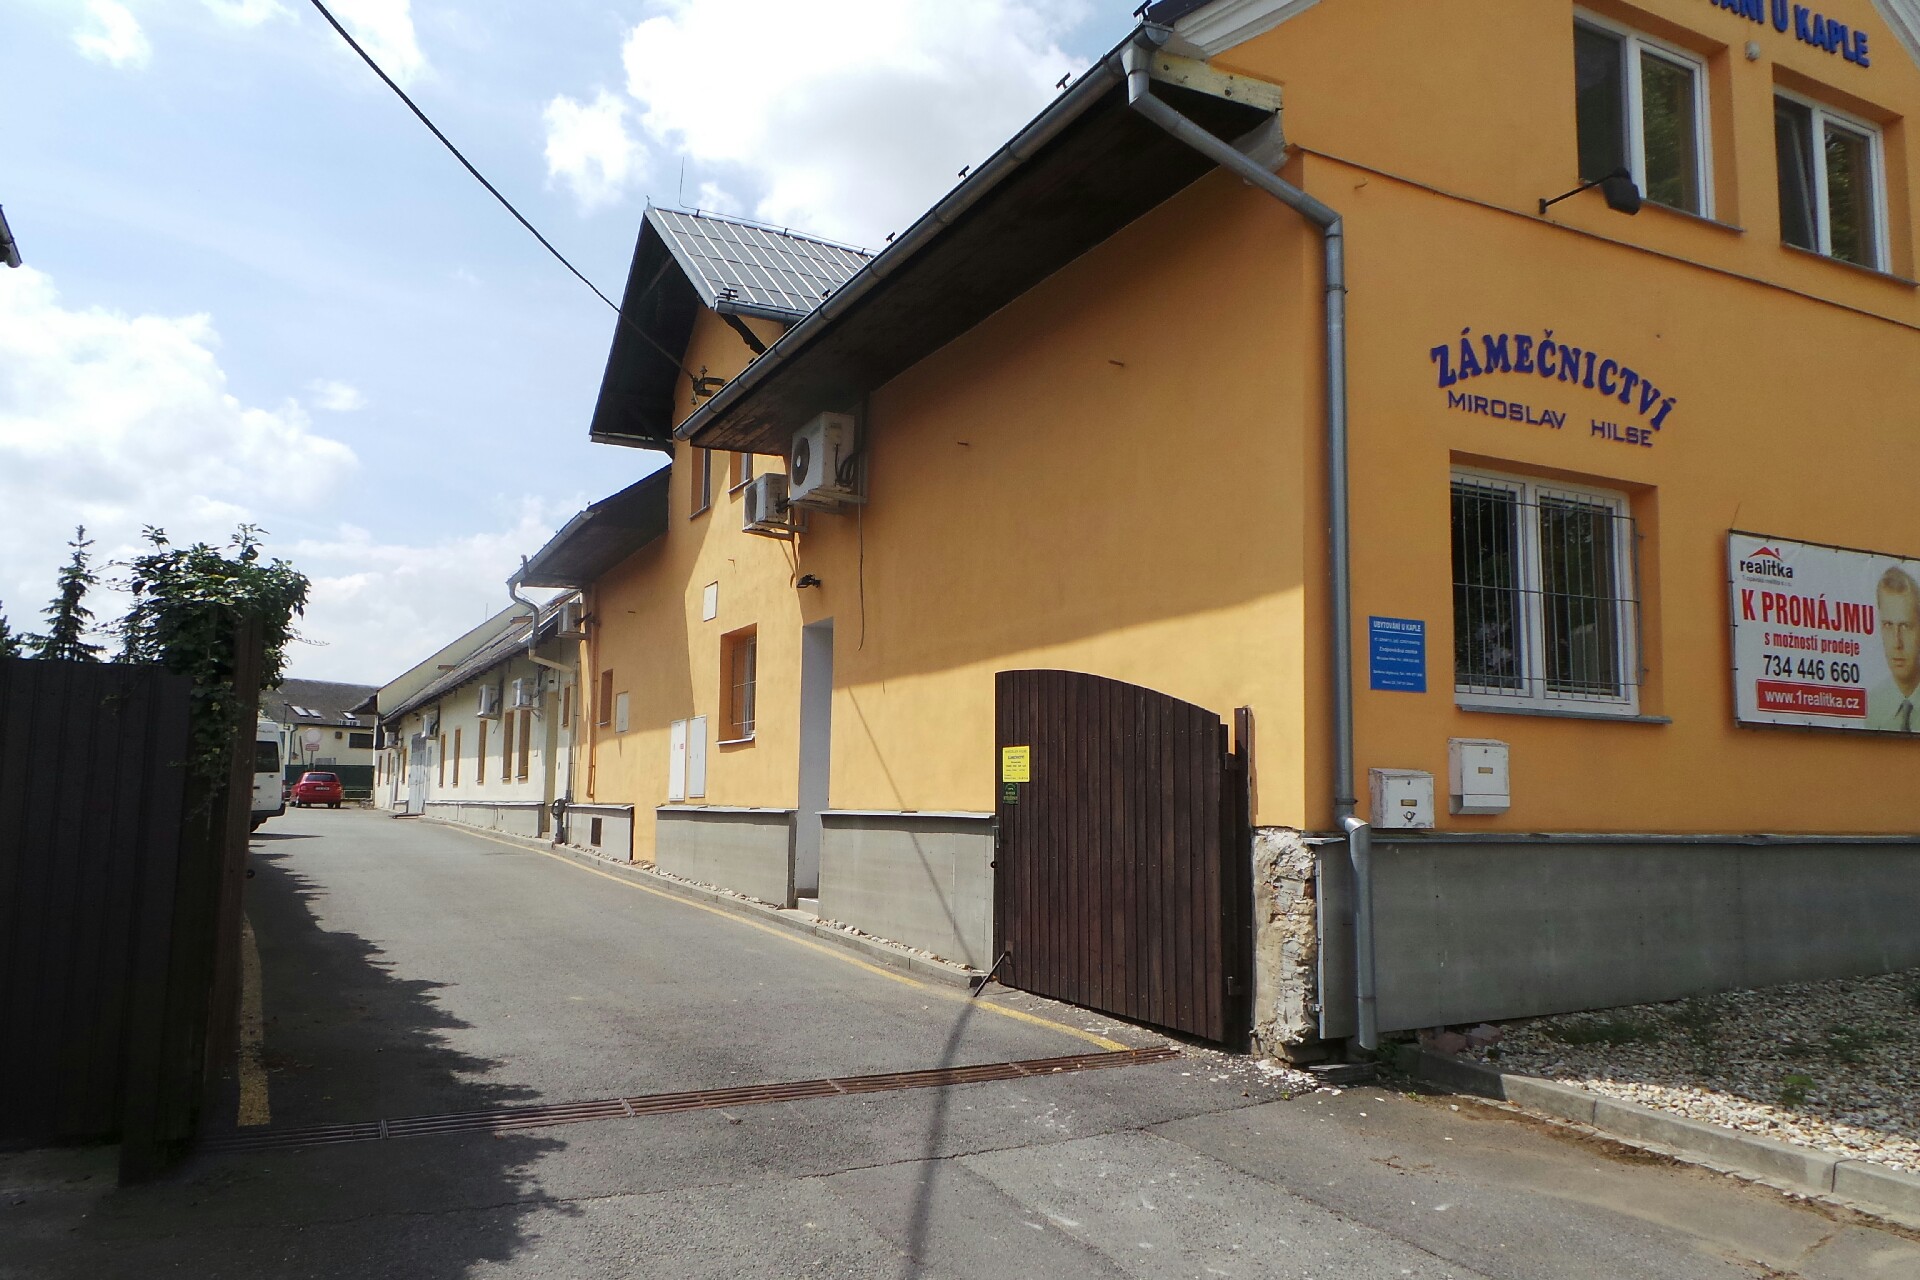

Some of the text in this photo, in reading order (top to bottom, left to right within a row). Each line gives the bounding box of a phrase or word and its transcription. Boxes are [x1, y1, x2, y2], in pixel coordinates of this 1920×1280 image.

[1771, 0, 1789, 33] U
[1794, 4, 1870, 68] KAPLE
[1430, 327, 1677, 431] ZÁMEČNICTVÍ
[1447, 389, 1653, 448] MIROSLAV HILSE
[1739, 559, 1793, 579] realitka
[1741, 588, 1874, 636] K PRONÁJMU
[1764, 632, 1860, 657] s možností prodeje
[1763, 654, 1860, 684] 734 446 660
[1764, 689, 1859, 710] www.1realitka.cz
